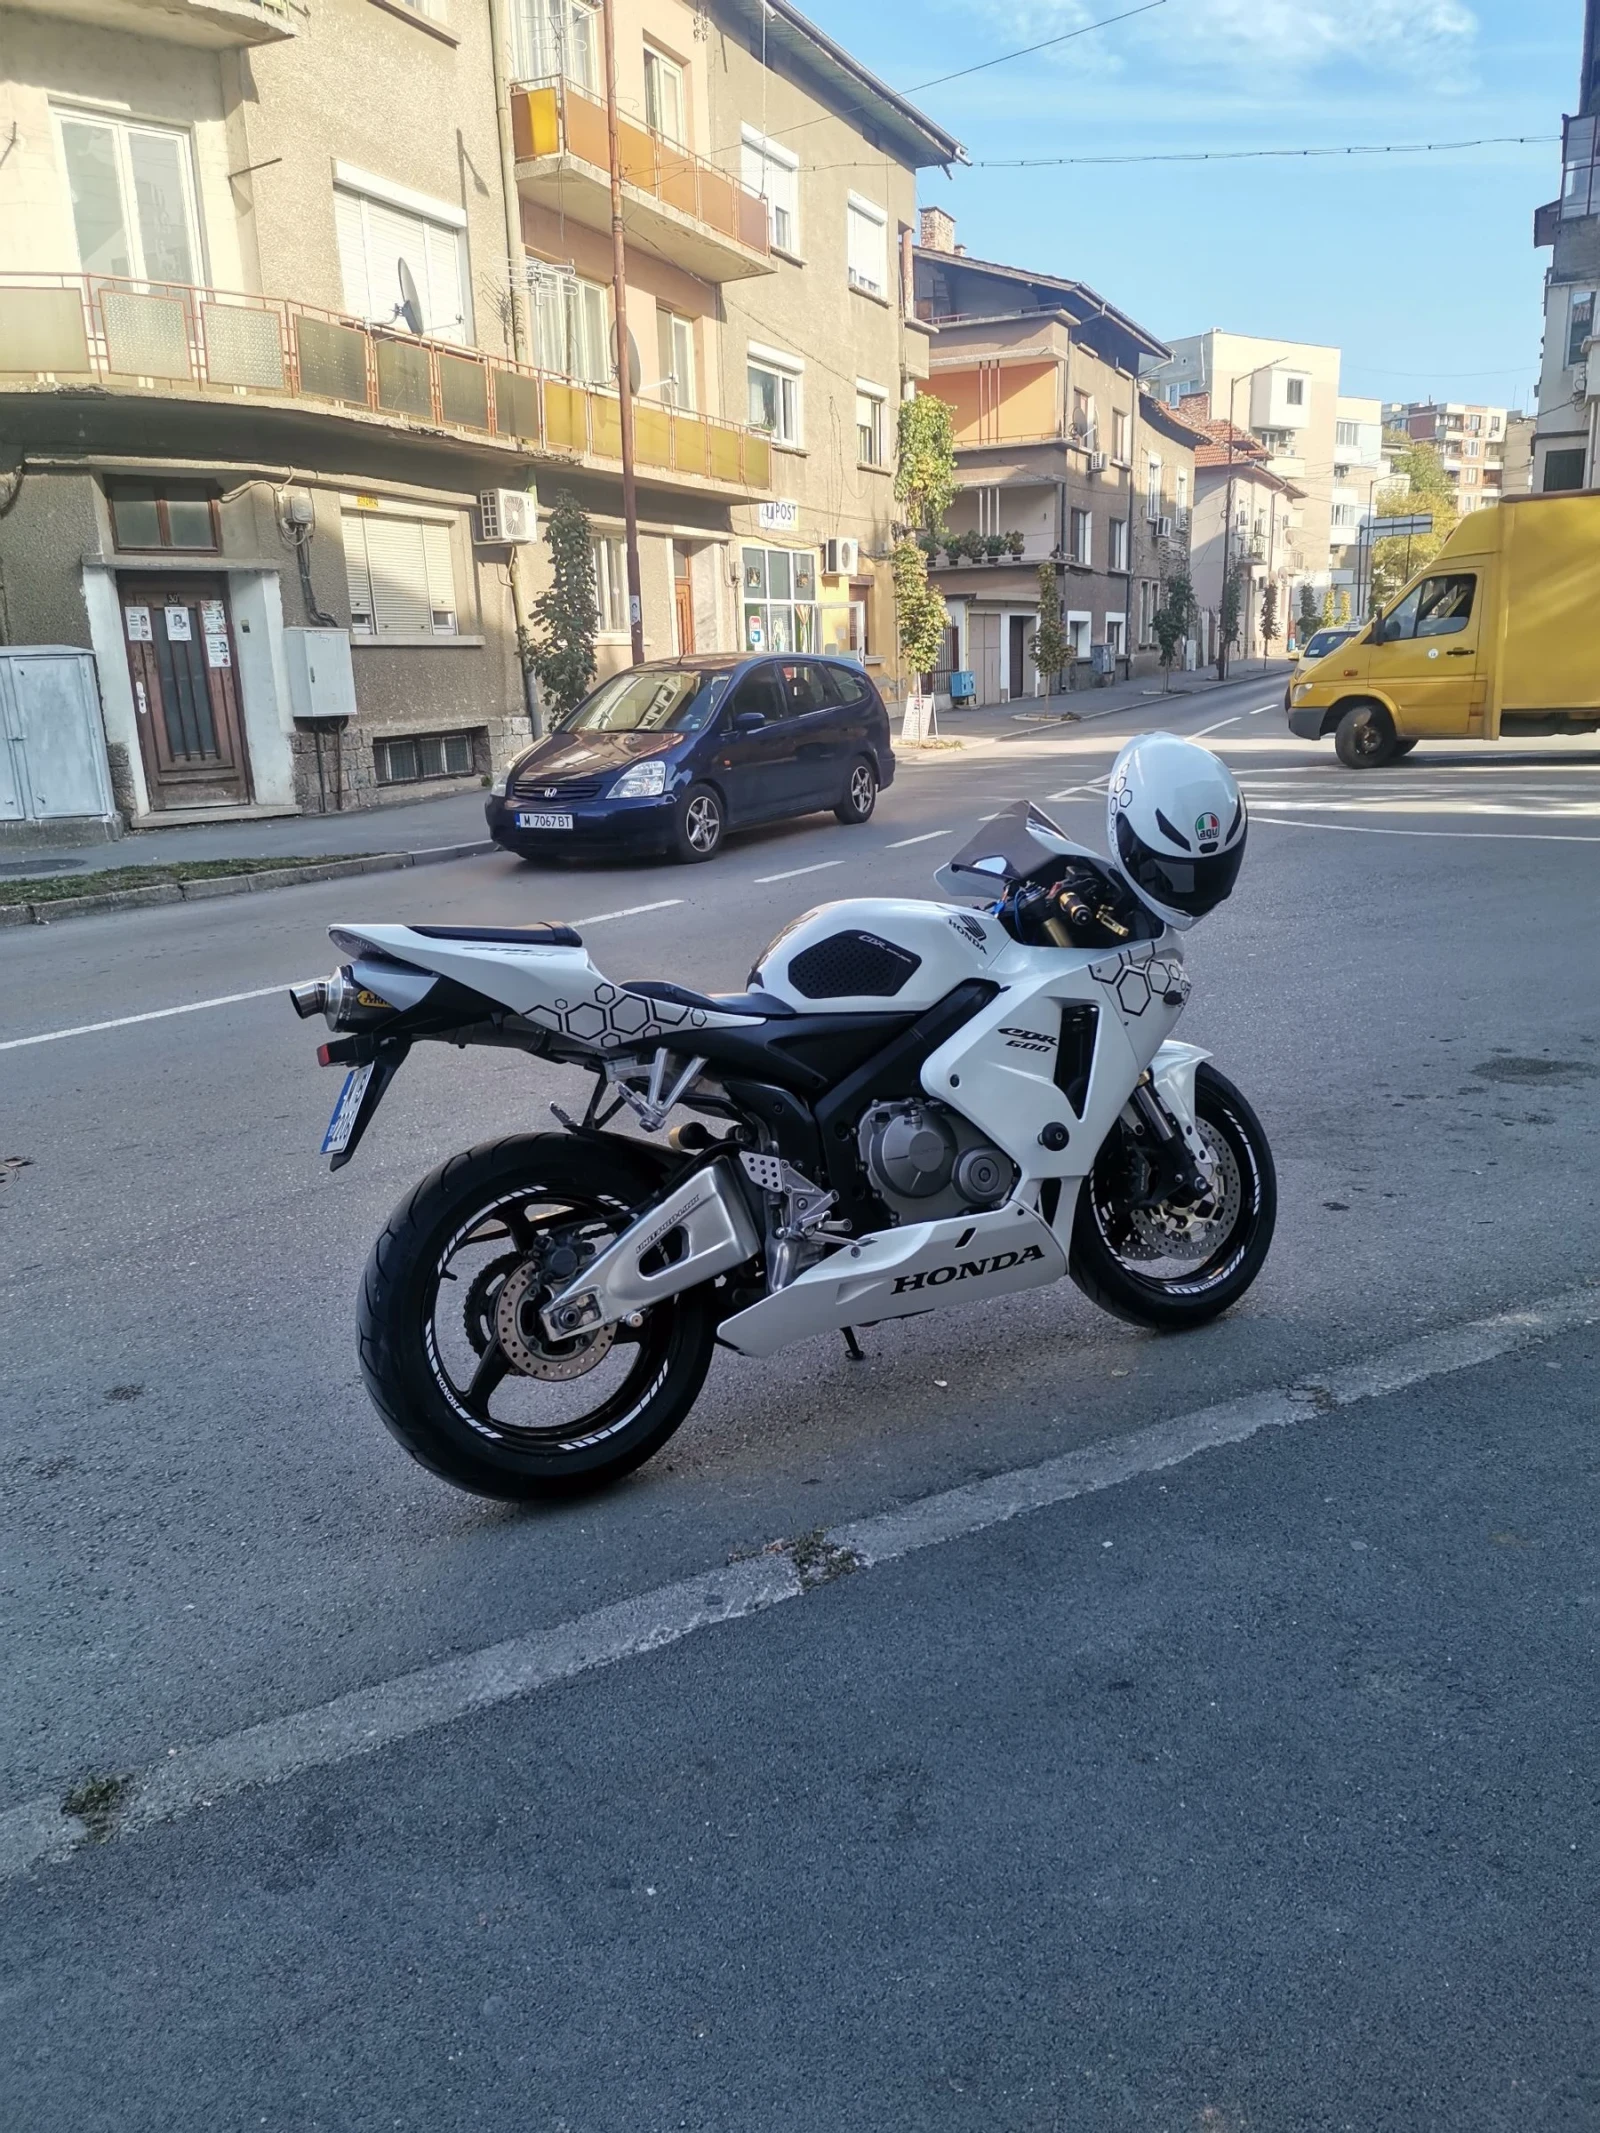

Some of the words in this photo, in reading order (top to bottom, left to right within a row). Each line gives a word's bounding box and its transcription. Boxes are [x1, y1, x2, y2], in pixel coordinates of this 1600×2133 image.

[534, 815, 557, 827] 7067
[557, 816, 570, 827] BT
[948, 918, 988, 955] HONDA
[997, 1027, 1058, 1046] CBR
[1005, 1040, 1051, 1053] 600
[890, 1244, 1045, 1295] HONDA
[436, 1371, 460, 1409] HONDA
